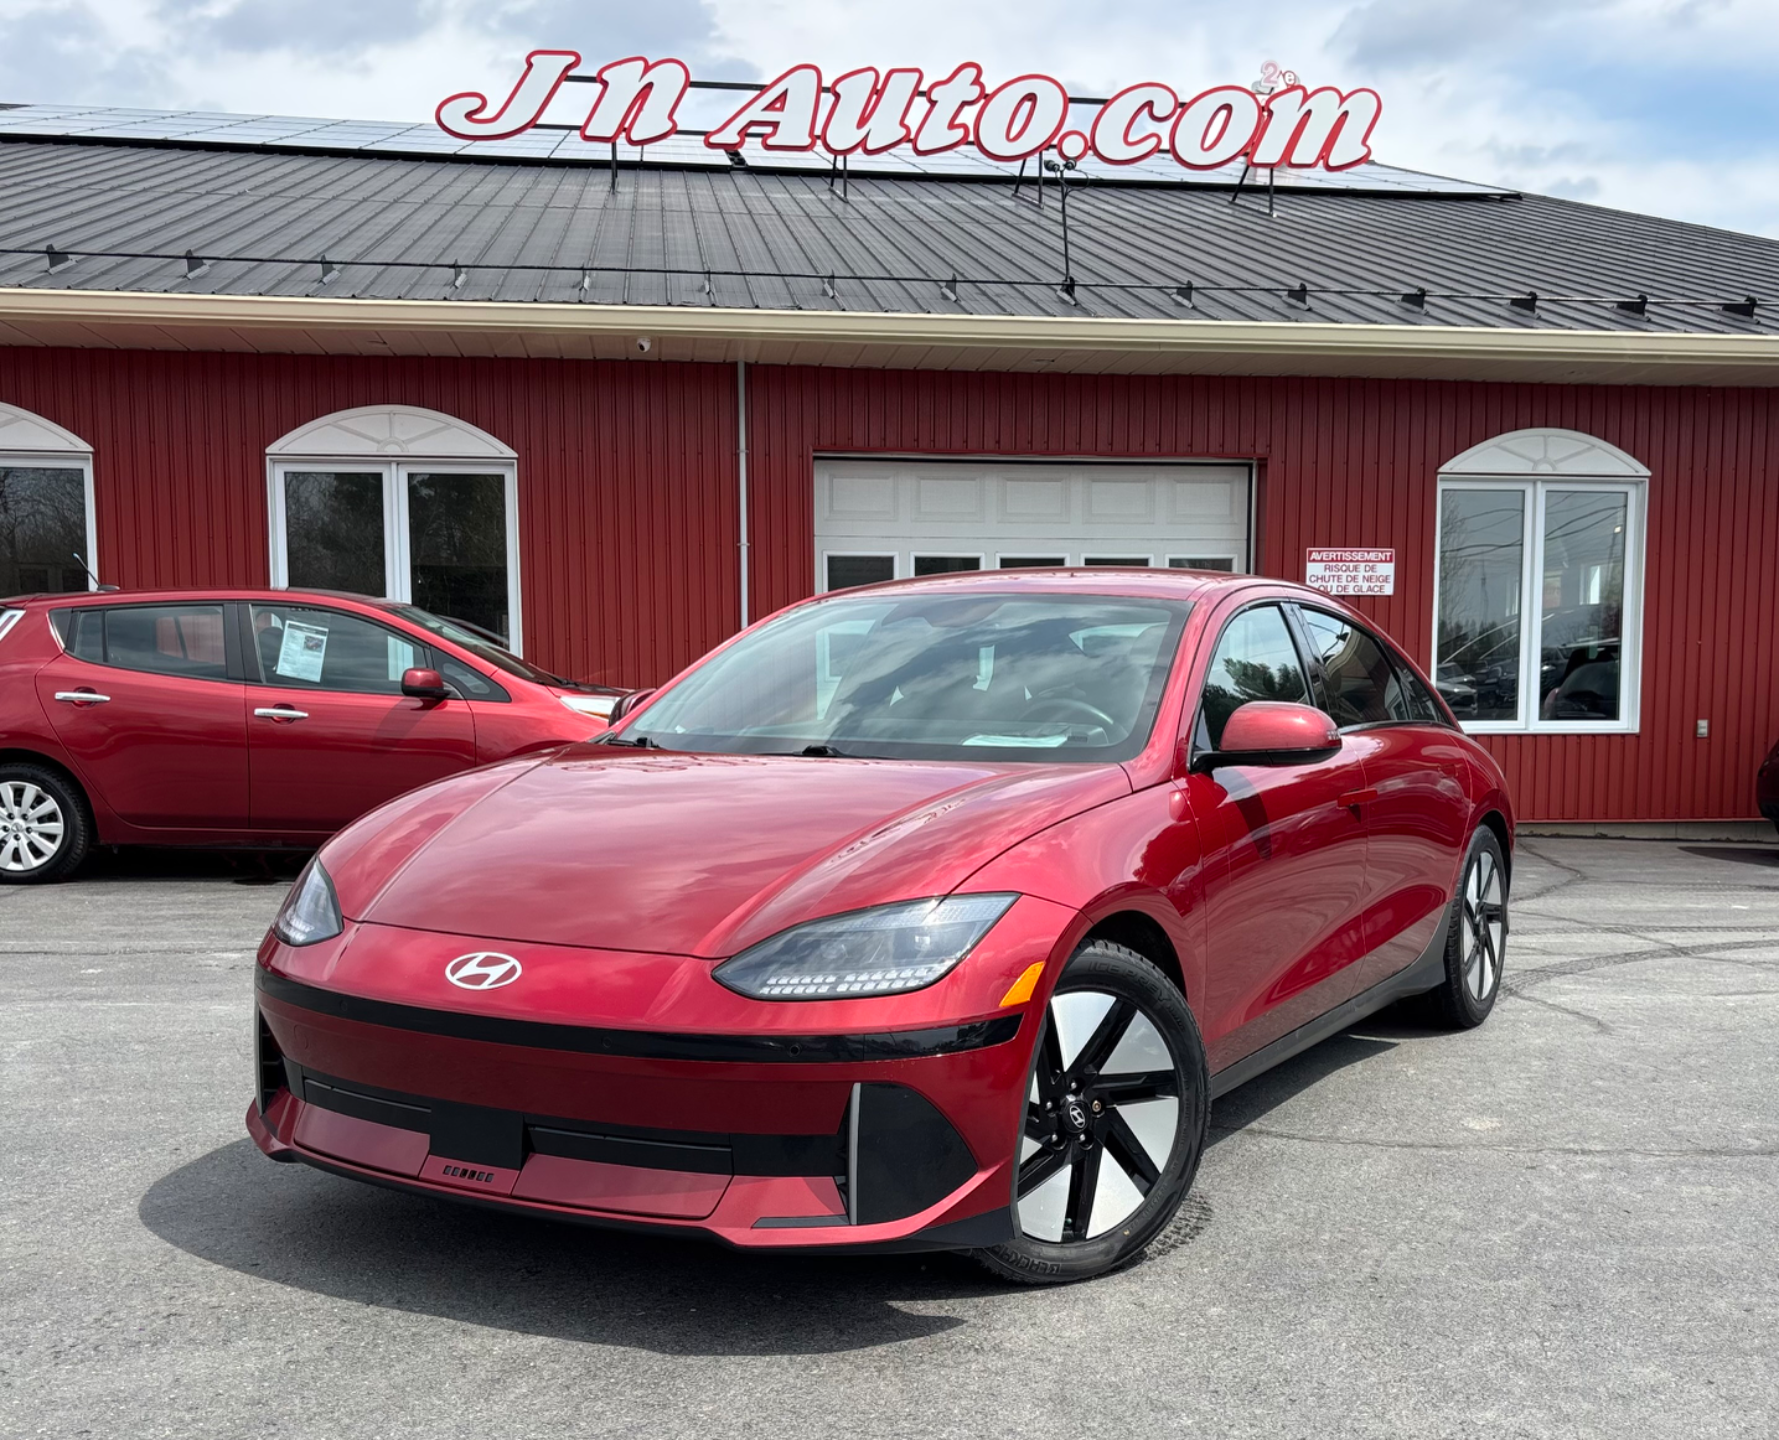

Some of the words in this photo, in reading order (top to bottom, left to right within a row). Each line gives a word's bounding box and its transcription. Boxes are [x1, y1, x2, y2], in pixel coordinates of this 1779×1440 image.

[436, 50, 690, 145] Jn
[704, 60, 1382, 172] Auto.com
[1310, 551, 1391, 561] AVERTISSEMENT
[1324, 564, 1361, 573] RISQUE
[1364, 564, 1377, 573] DE
[1309, 574, 1343, 583] CHUTE
[1346, 575, 1359, 583] DE
[1362, 575, 1391, 583] NEIGE
[1336, 585, 1350, 593] DE
[1353, 585, 1385, 593] GLACE
[1122, 968, 1171, 1001] PREY
